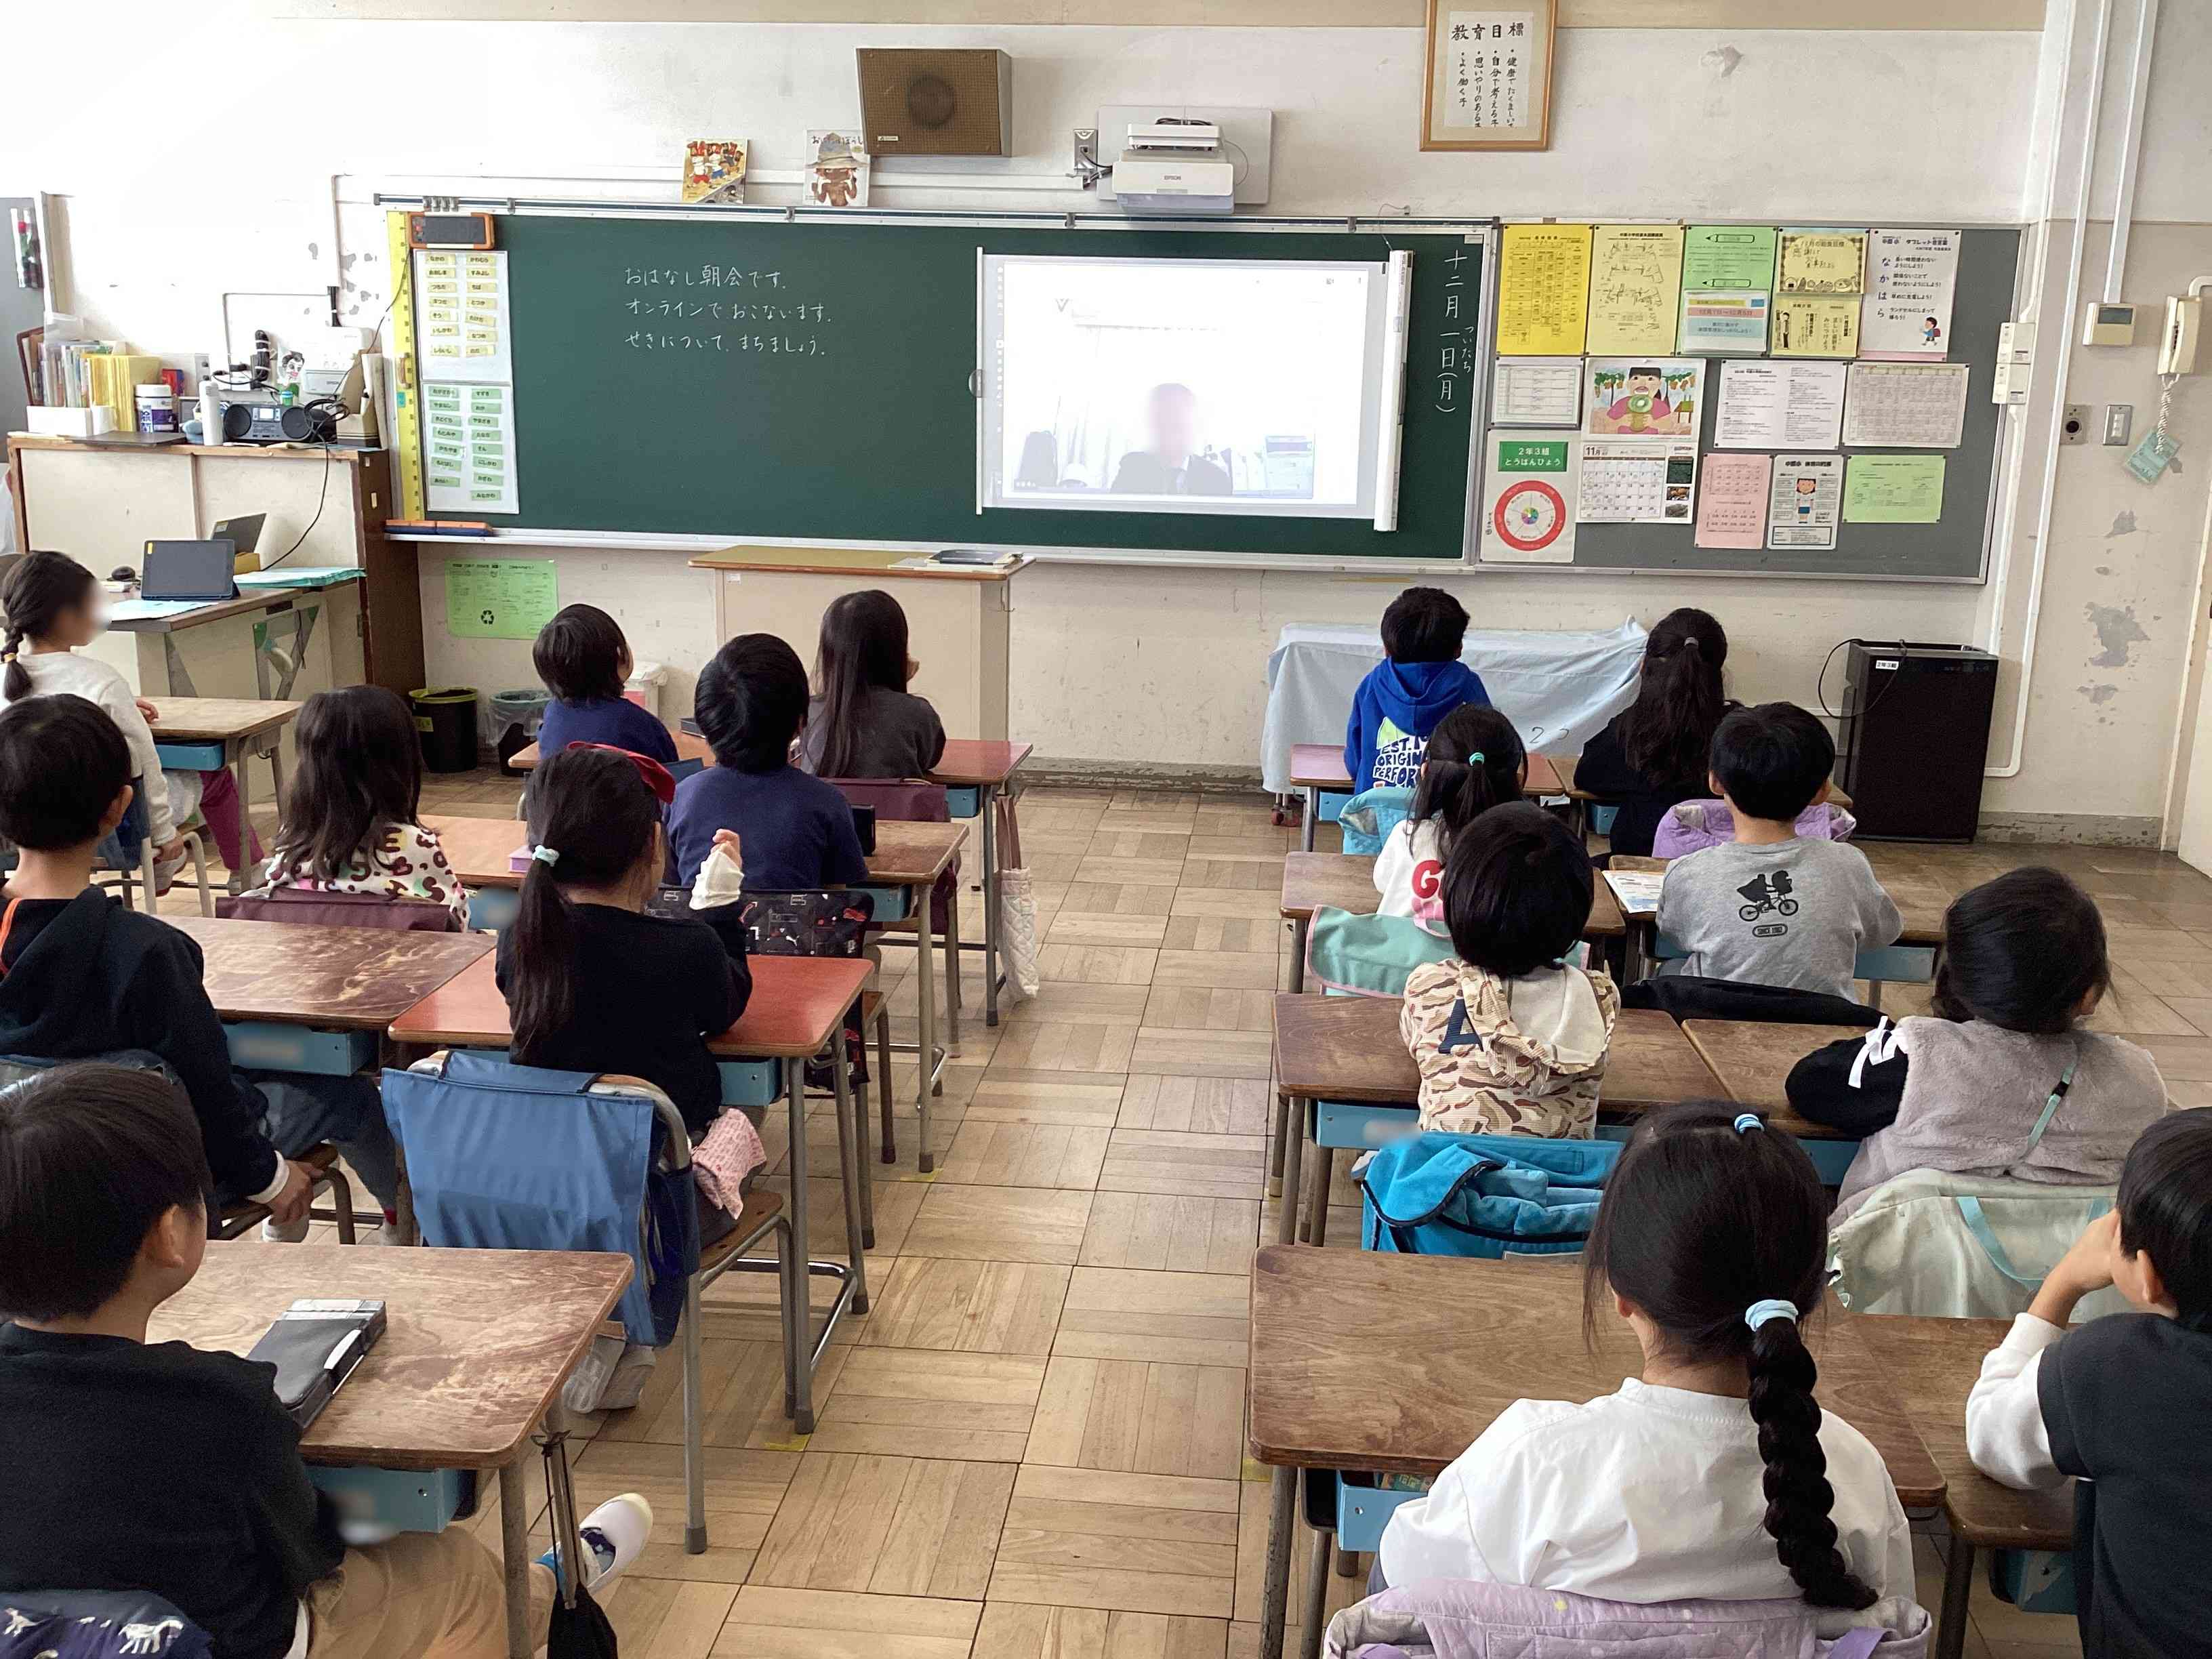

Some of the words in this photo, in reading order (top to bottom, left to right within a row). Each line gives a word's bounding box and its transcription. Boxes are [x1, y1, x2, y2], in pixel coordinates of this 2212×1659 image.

[1451, 22, 1525, 41] 教育目標
[1882, 257, 1891, 266] な
[625, 264, 786, 289] おはなし朝会です。
[1879, 274, 1889, 283] か
[1878, 292, 1887, 300] は
[1877, 308, 1885, 318] ら
[1461, 326, 1475, 373] ついたち
[1518, 447, 1551, 455] 2年3組
[1504, 458, 1561, 466] とうばんひょう
[1381, 736, 1412, 754] EST.
[1376, 750, 1422, 766] ORIGIN
[1374, 766, 1418, 787] PERFOR
[1438, 998, 1485, 1054] A
